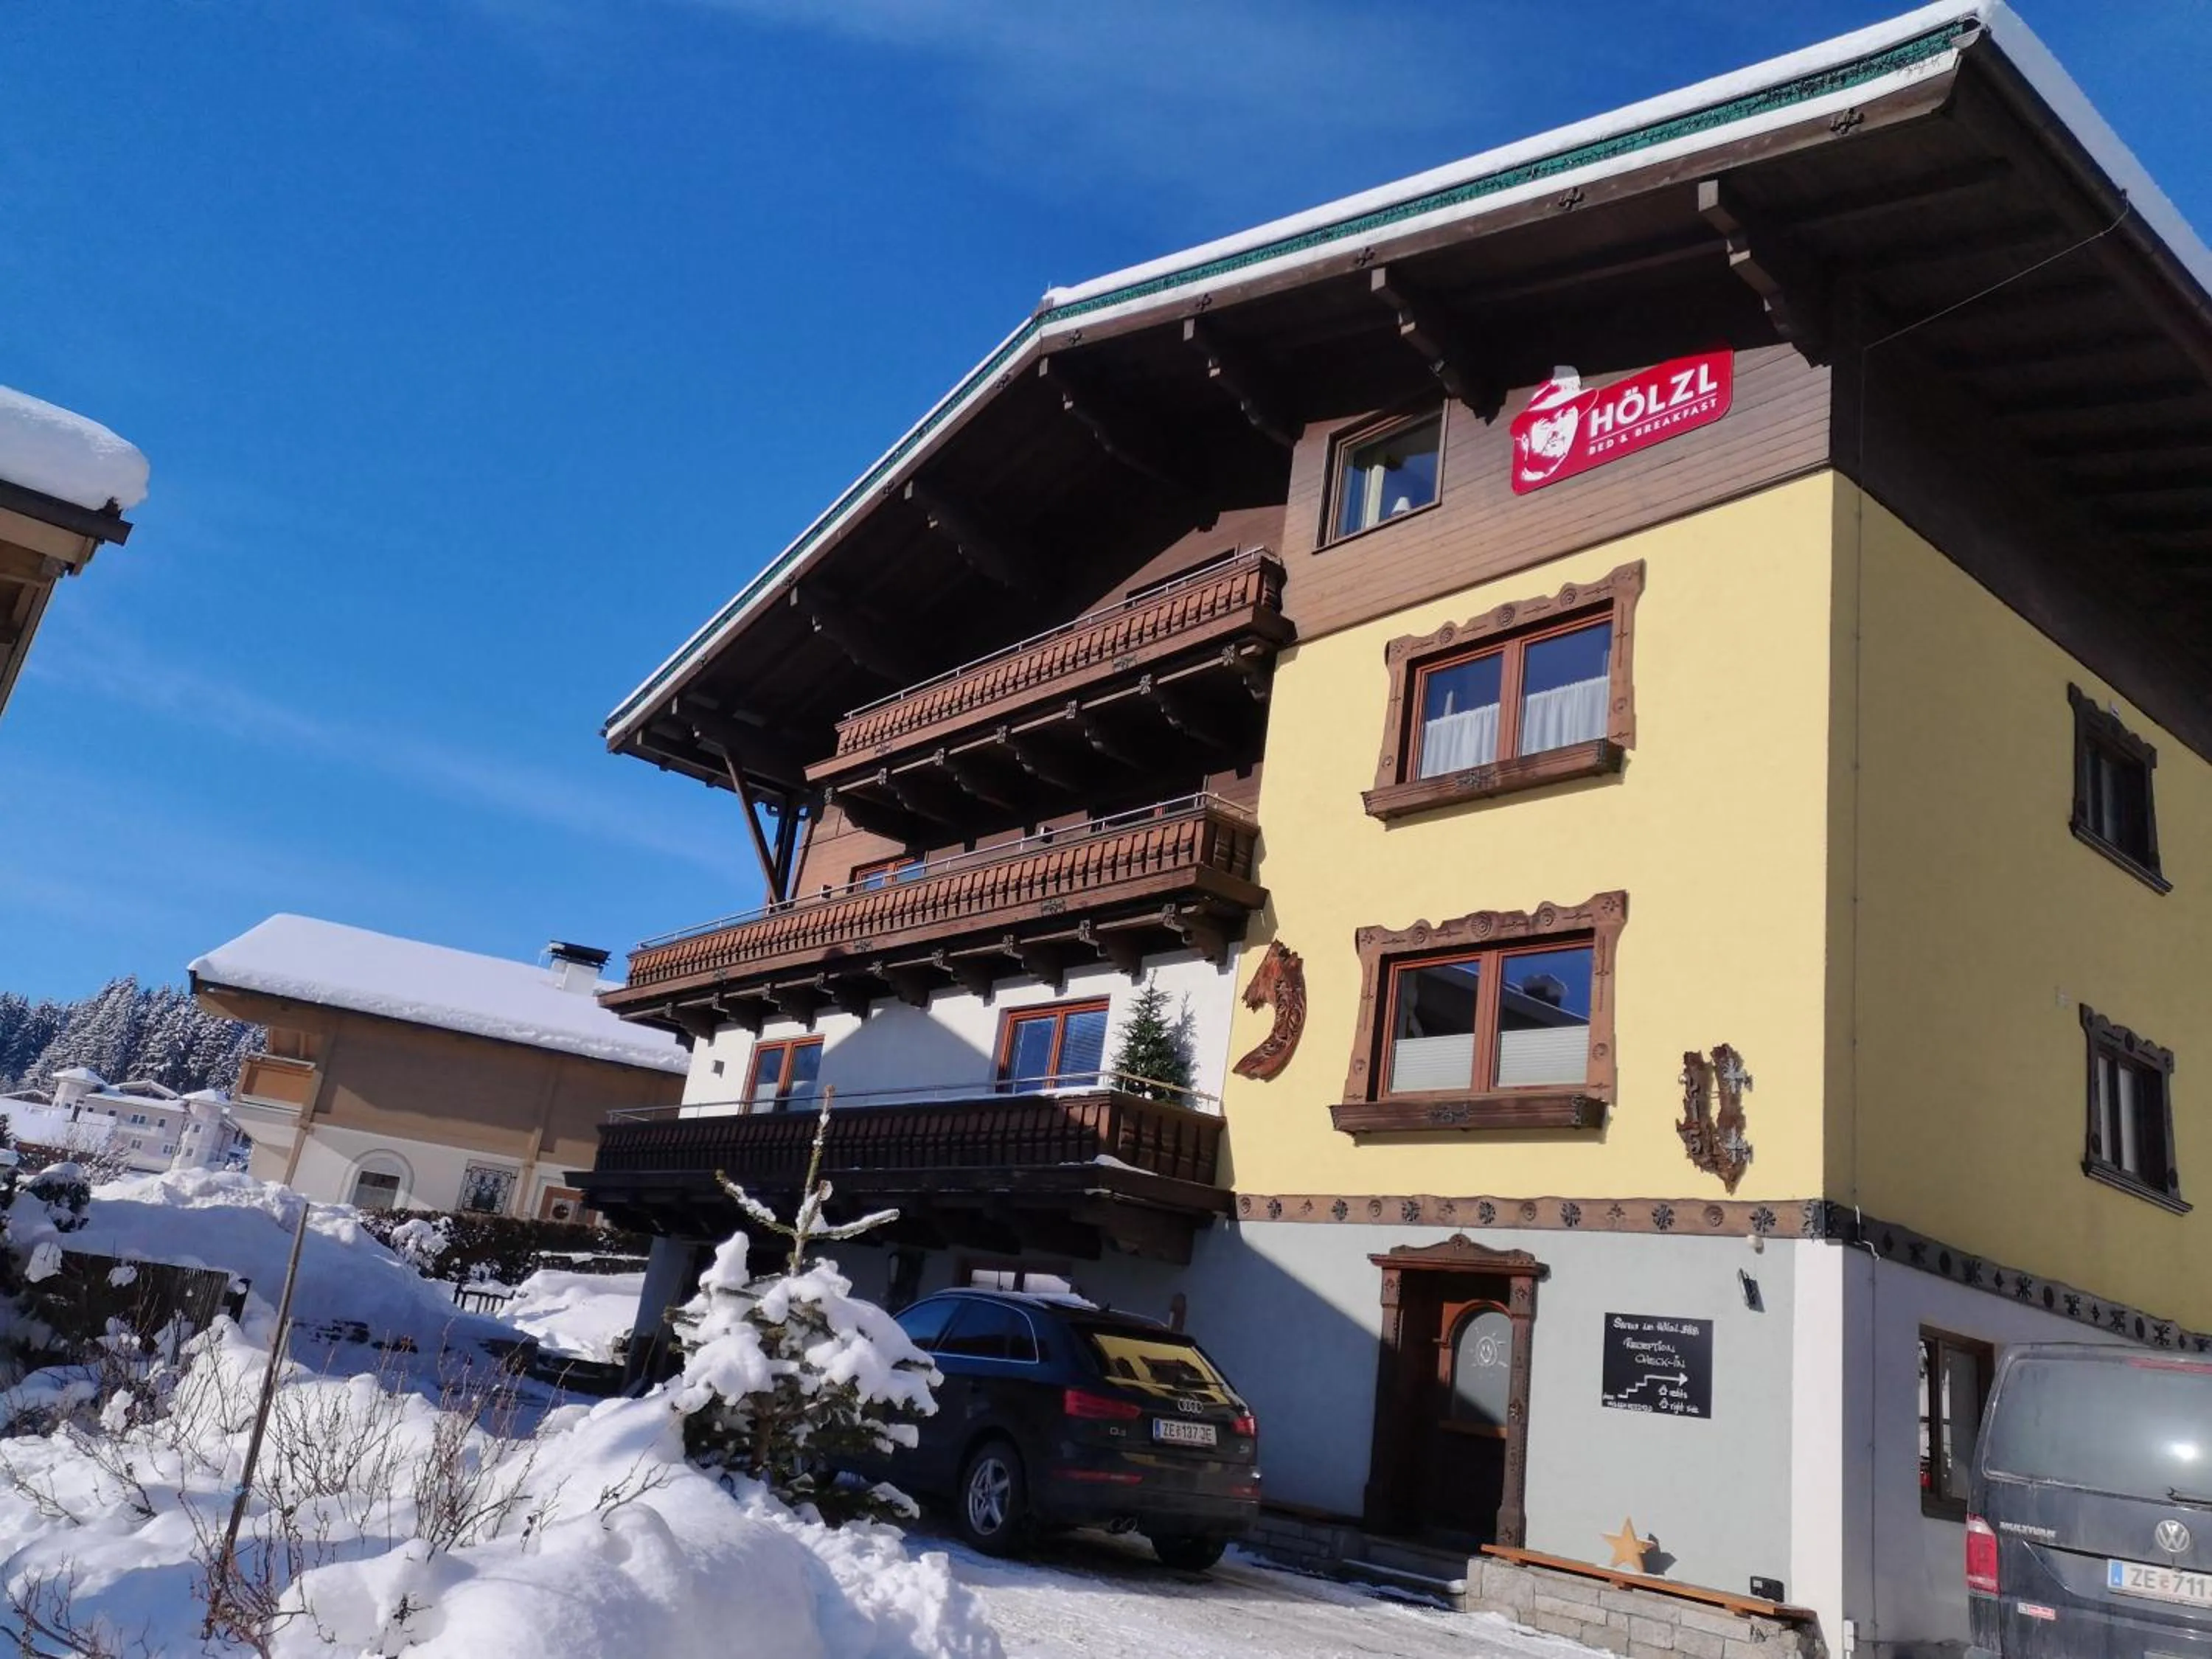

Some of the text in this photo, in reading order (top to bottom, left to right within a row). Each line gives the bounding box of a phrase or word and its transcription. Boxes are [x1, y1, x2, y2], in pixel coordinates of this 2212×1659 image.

[1587, 397, 1718, 456] BED & BREAKFAST
[1590, 363, 1718, 437] HÖLZL
